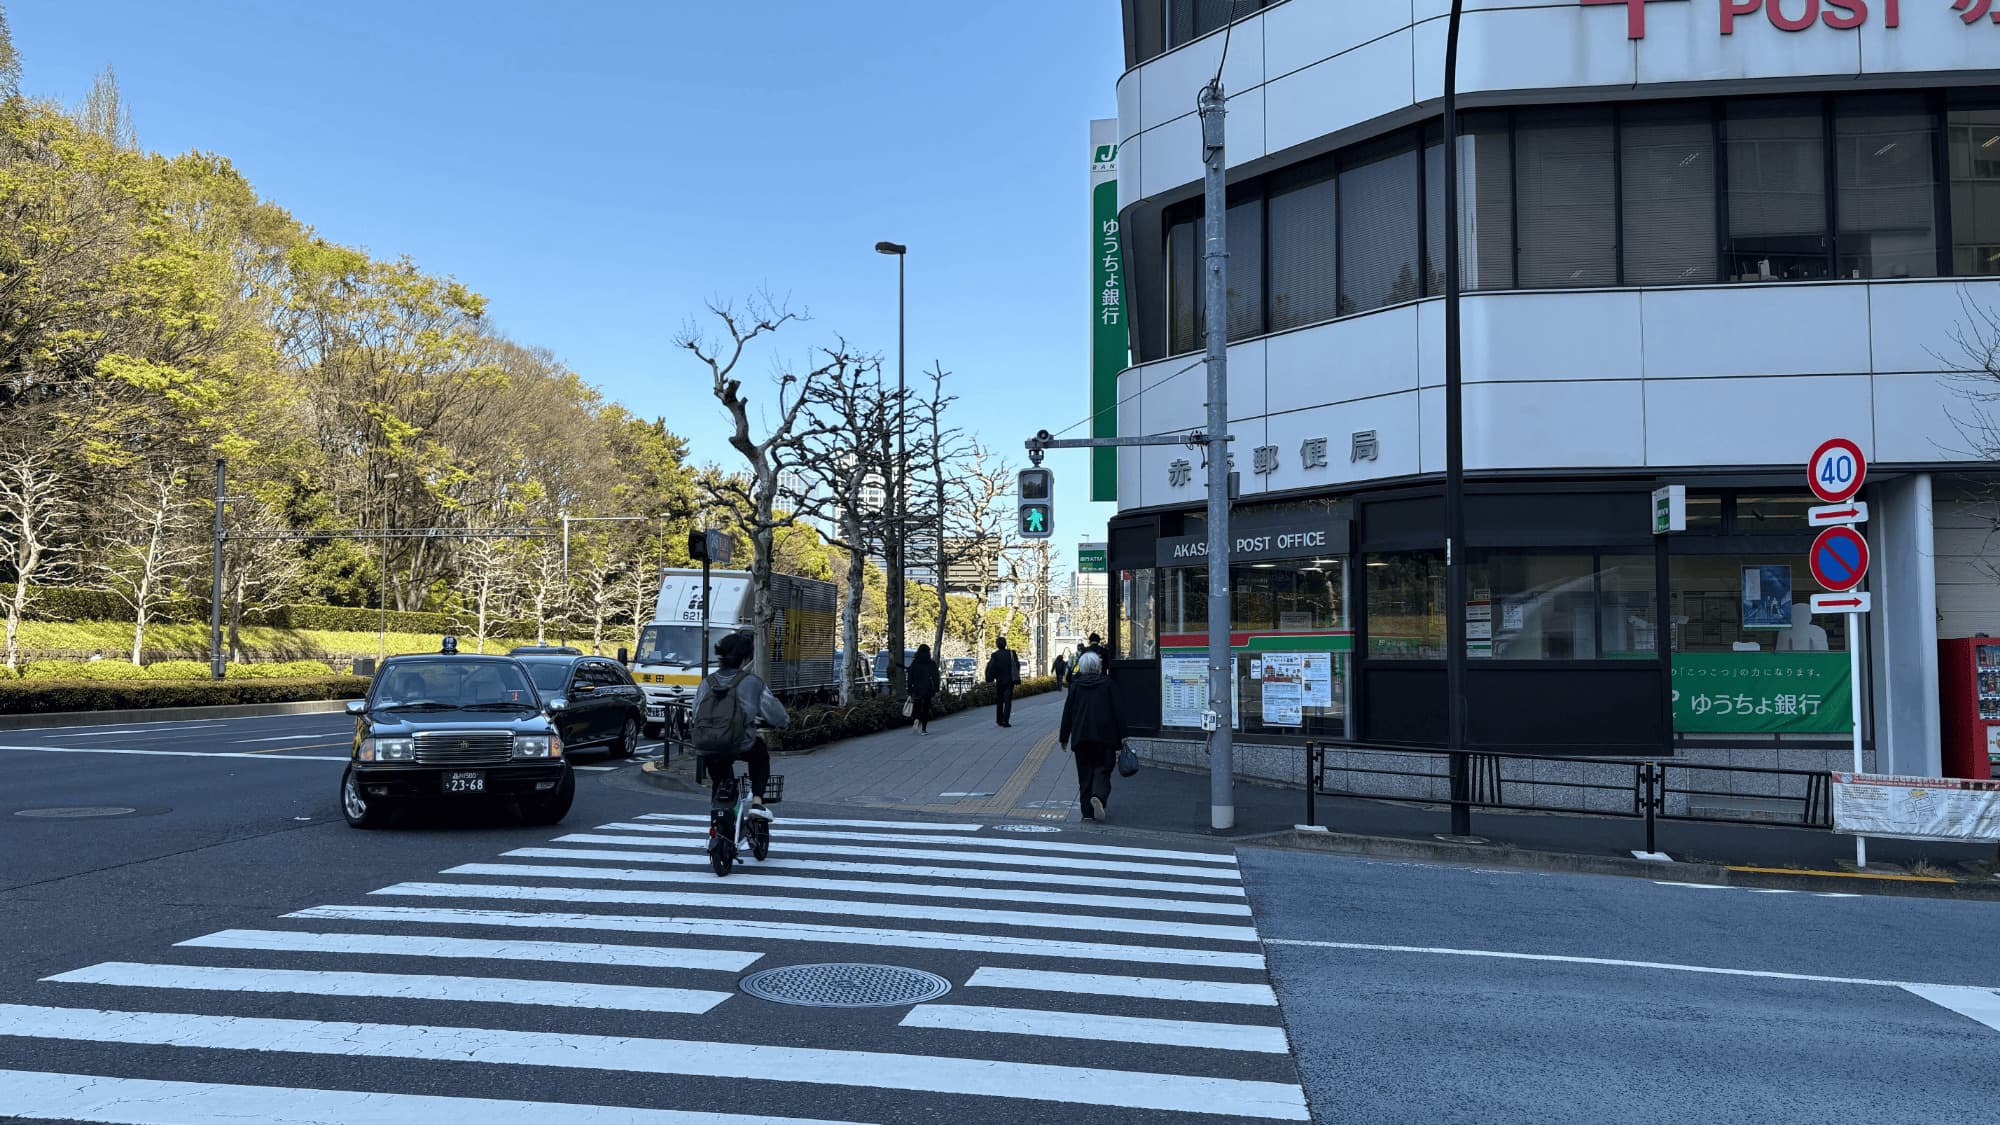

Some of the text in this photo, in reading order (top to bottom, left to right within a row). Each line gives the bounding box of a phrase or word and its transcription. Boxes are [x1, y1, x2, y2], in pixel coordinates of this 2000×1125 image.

[1102, 218, 1119, 325] ゆうちょ銀行
[1168, 429, 1379, 487] 赤郵便局
[1821, 455, 1852, 484] 40
[1173, 531, 1326, 558] AKASA POST OFFICE
[683, 611, 704, 621] 621
[1691, 693, 1822, 715] ゆうちょ銀行
[451, 780, 483, 791] 23-68
